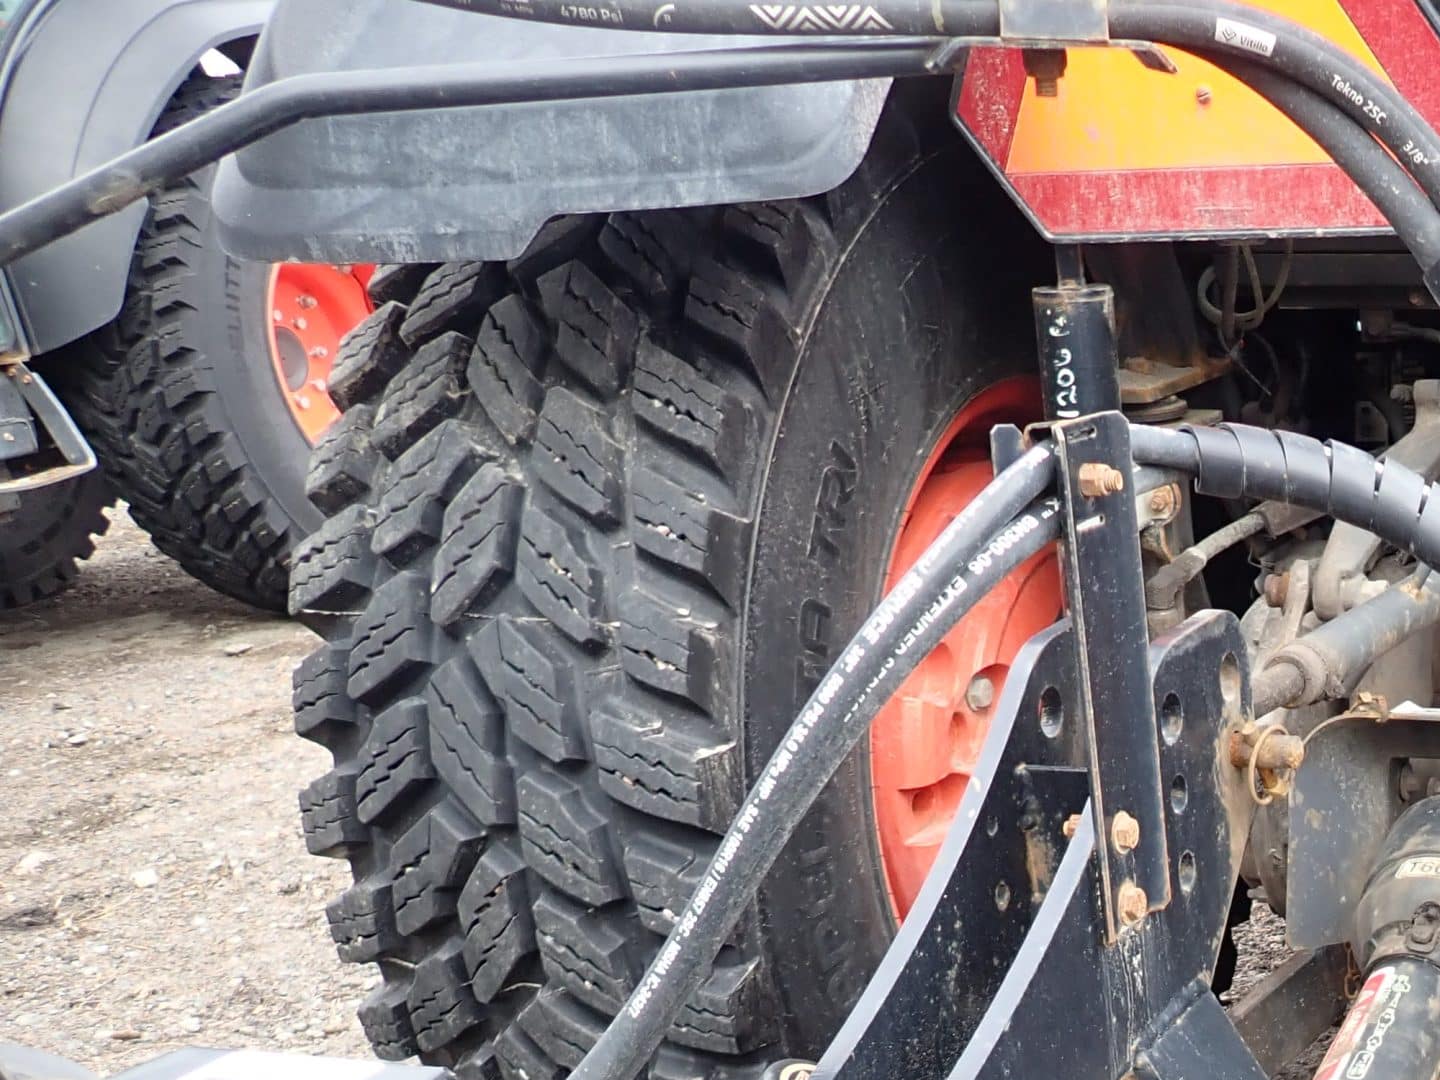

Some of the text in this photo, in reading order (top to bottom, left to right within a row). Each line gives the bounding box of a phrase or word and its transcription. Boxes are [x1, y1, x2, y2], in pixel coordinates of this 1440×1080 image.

[560, 5, 598, 20] 4780
[1239, 34, 1269, 53] Vitillo
[1331, 74, 1364, 107] Tekno
[1362, 101, 1387, 126] 2SC
[1403, 140, 1430, 166] 3/8"
[862, 570, 923, 644] SERVICE
[737, 804, 758, 832] SAE
